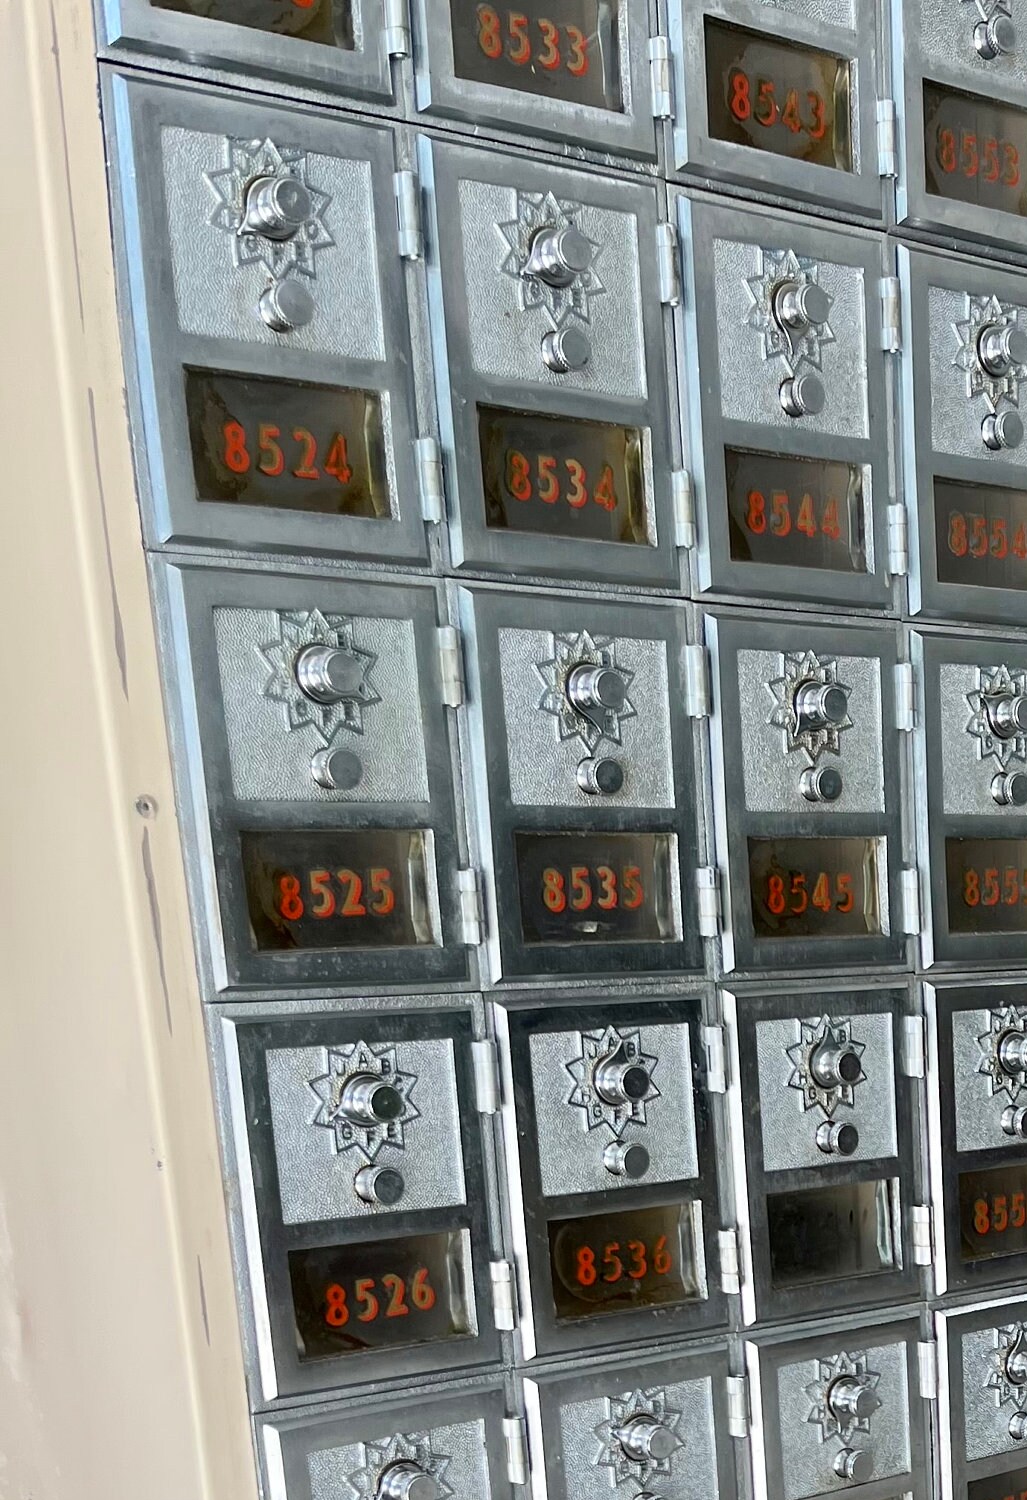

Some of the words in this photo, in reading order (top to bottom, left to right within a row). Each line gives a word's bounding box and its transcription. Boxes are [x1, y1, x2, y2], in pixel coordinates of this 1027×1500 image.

[476, 4, 589, 76] 8533
[730, 74, 826, 139] 8543
[938, 128, 1020, 187] 8553
[224, 421, 351, 483] 8524
[507, 449, 617, 511] 8534
[747, 491, 840, 539] 8544
[279, 870, 395, 921] 8525
[543, 866, 644, 913] 8535
[767, 874, 854, 915] 8545
[358, 1052, 369, 1068] A
[381, 1058, 391, 1075] B
[627, 1042, 636, 1057] B
[576, 1236, 672, 1287] 8536
[325, 1269, 435, 1328] 8526
